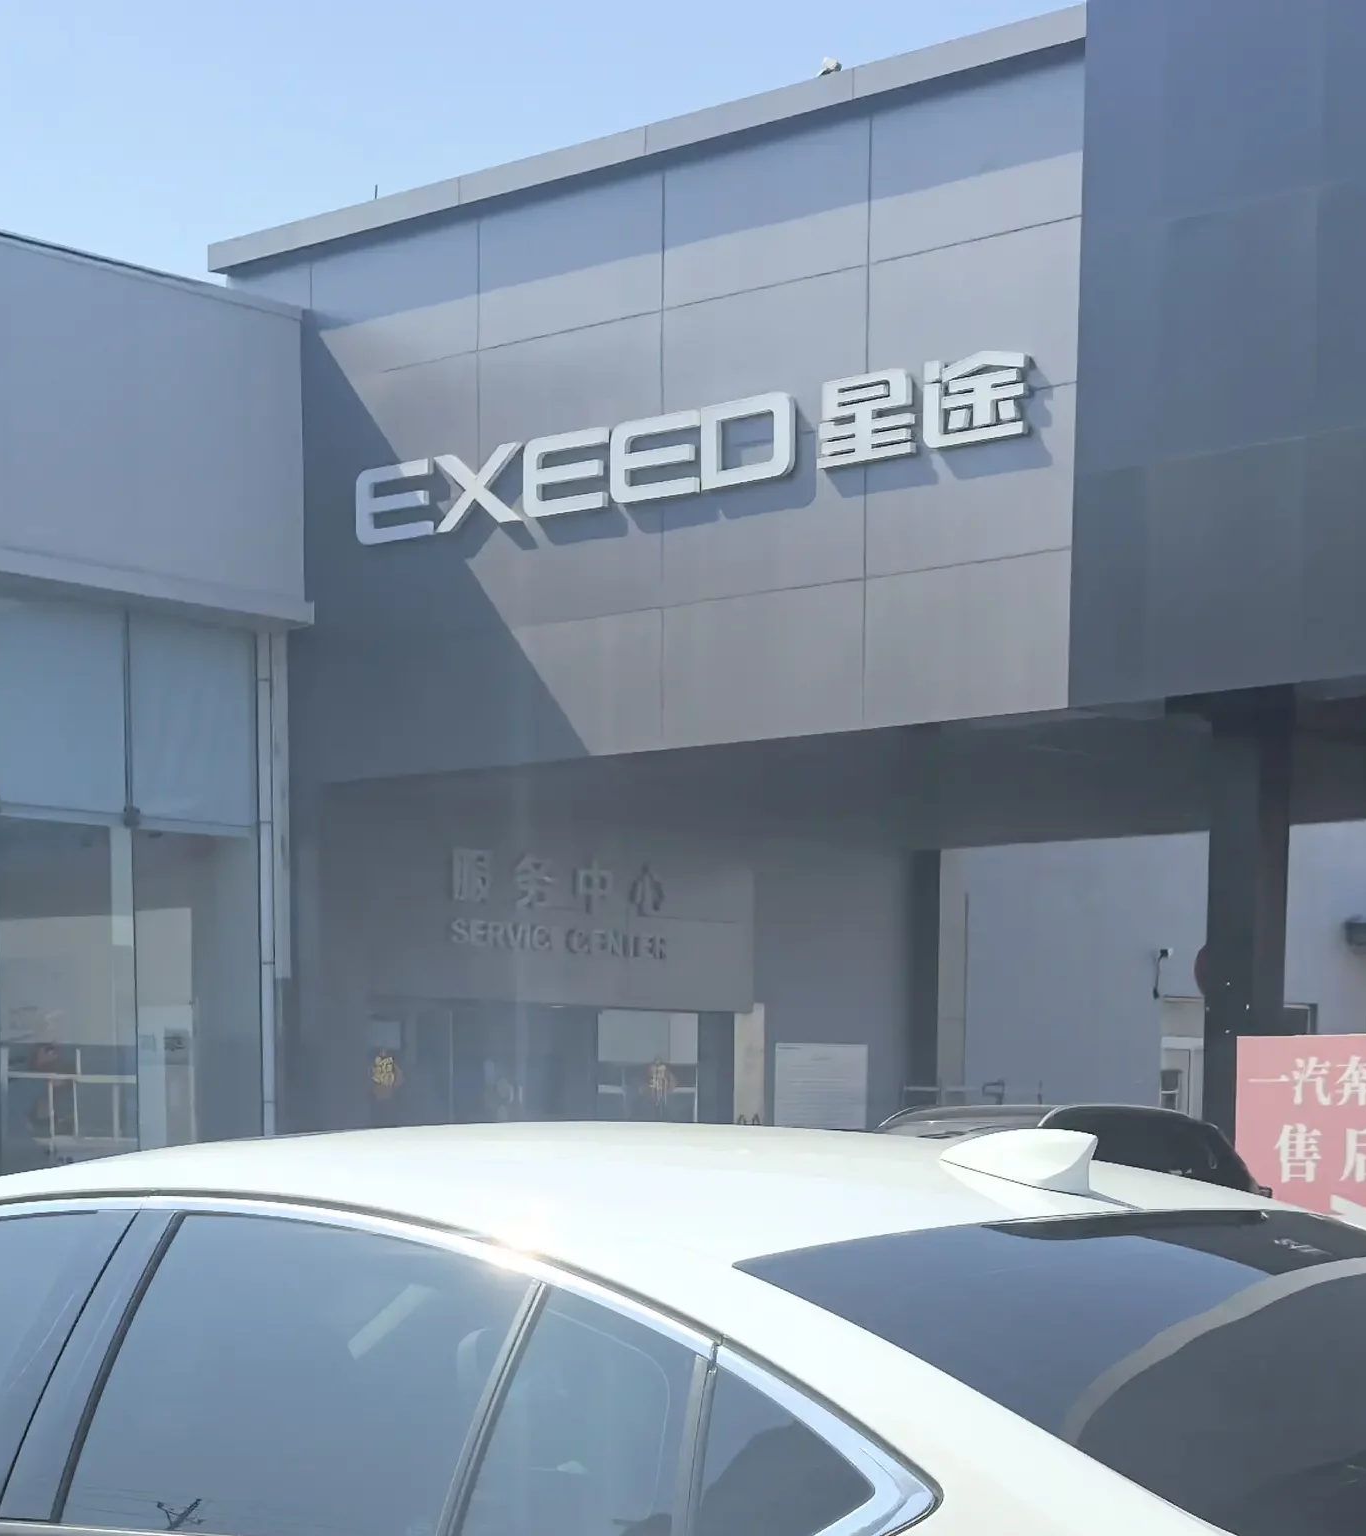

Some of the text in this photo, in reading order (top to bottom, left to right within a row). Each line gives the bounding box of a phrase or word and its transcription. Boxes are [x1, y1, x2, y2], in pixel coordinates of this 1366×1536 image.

[355, 350, 1031, 546] EXEED 星途
[450, 848, 665, 917] 服务中心
[566, 929, 666, 959] CENTER
